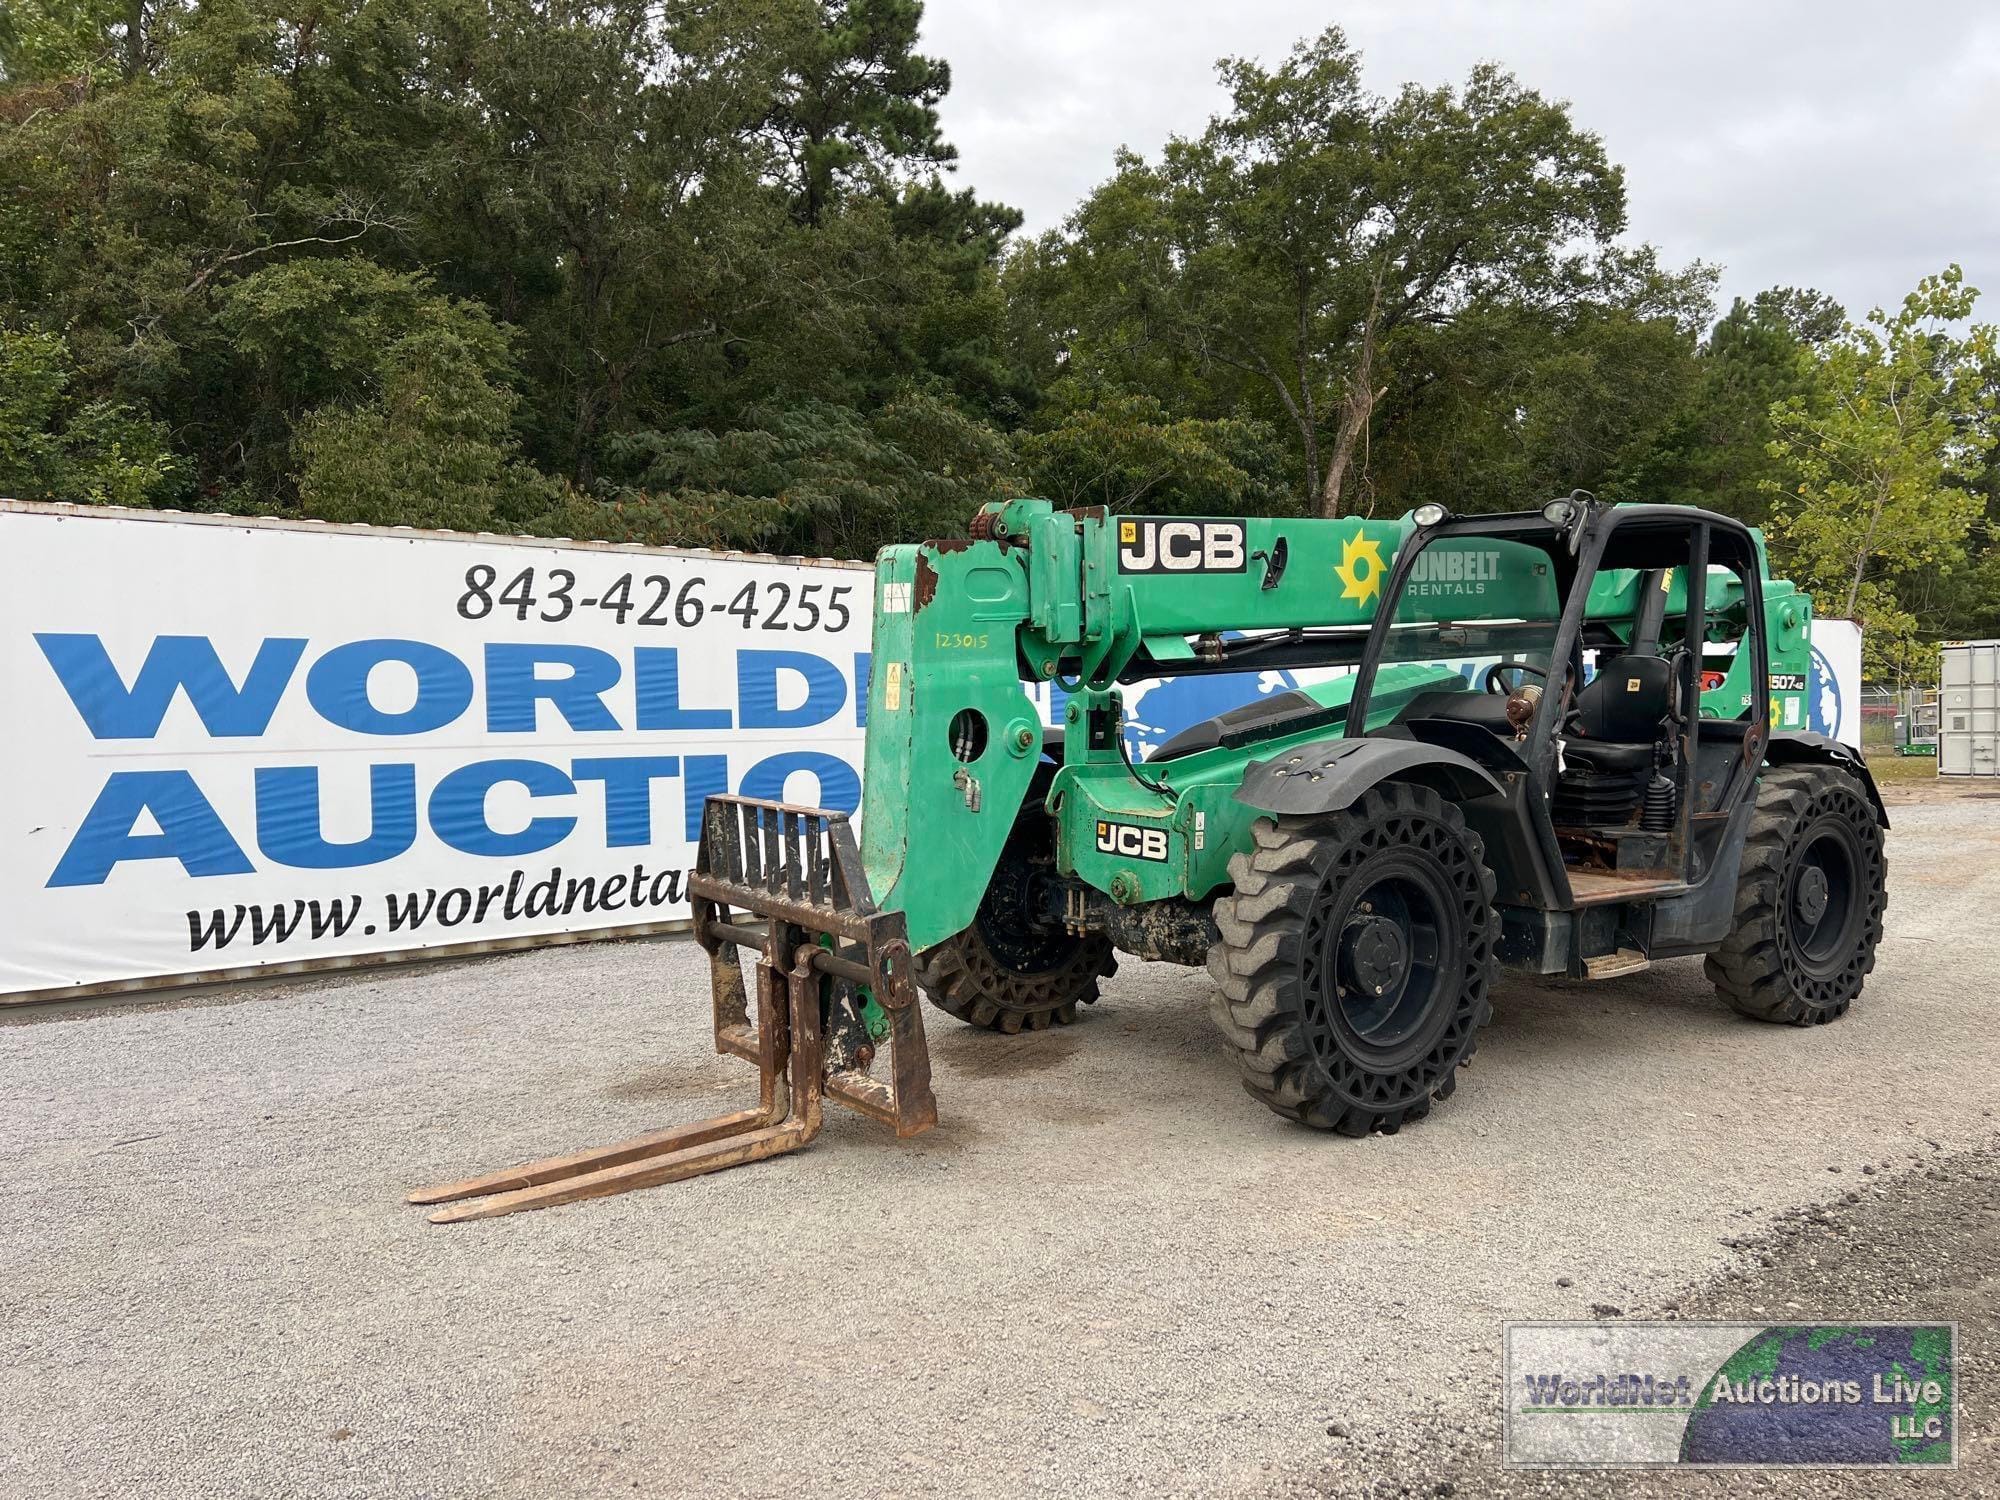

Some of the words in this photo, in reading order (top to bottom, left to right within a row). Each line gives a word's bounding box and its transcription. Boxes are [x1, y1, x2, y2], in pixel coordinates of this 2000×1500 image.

[1121, 523, 1244, 570] JCB
[456, 564, 852, 633] 843-426-4255
[1408, 583, 1485, 596] RENTALS
[936, 633, 988, 649] 123015
[33, 633, 873, 740] WORLD
[45, 751, 862, 888] AUCTIO
[1098, 823, 1167, 860] JCB
[187, 864, 694, 953] www.worldneta
